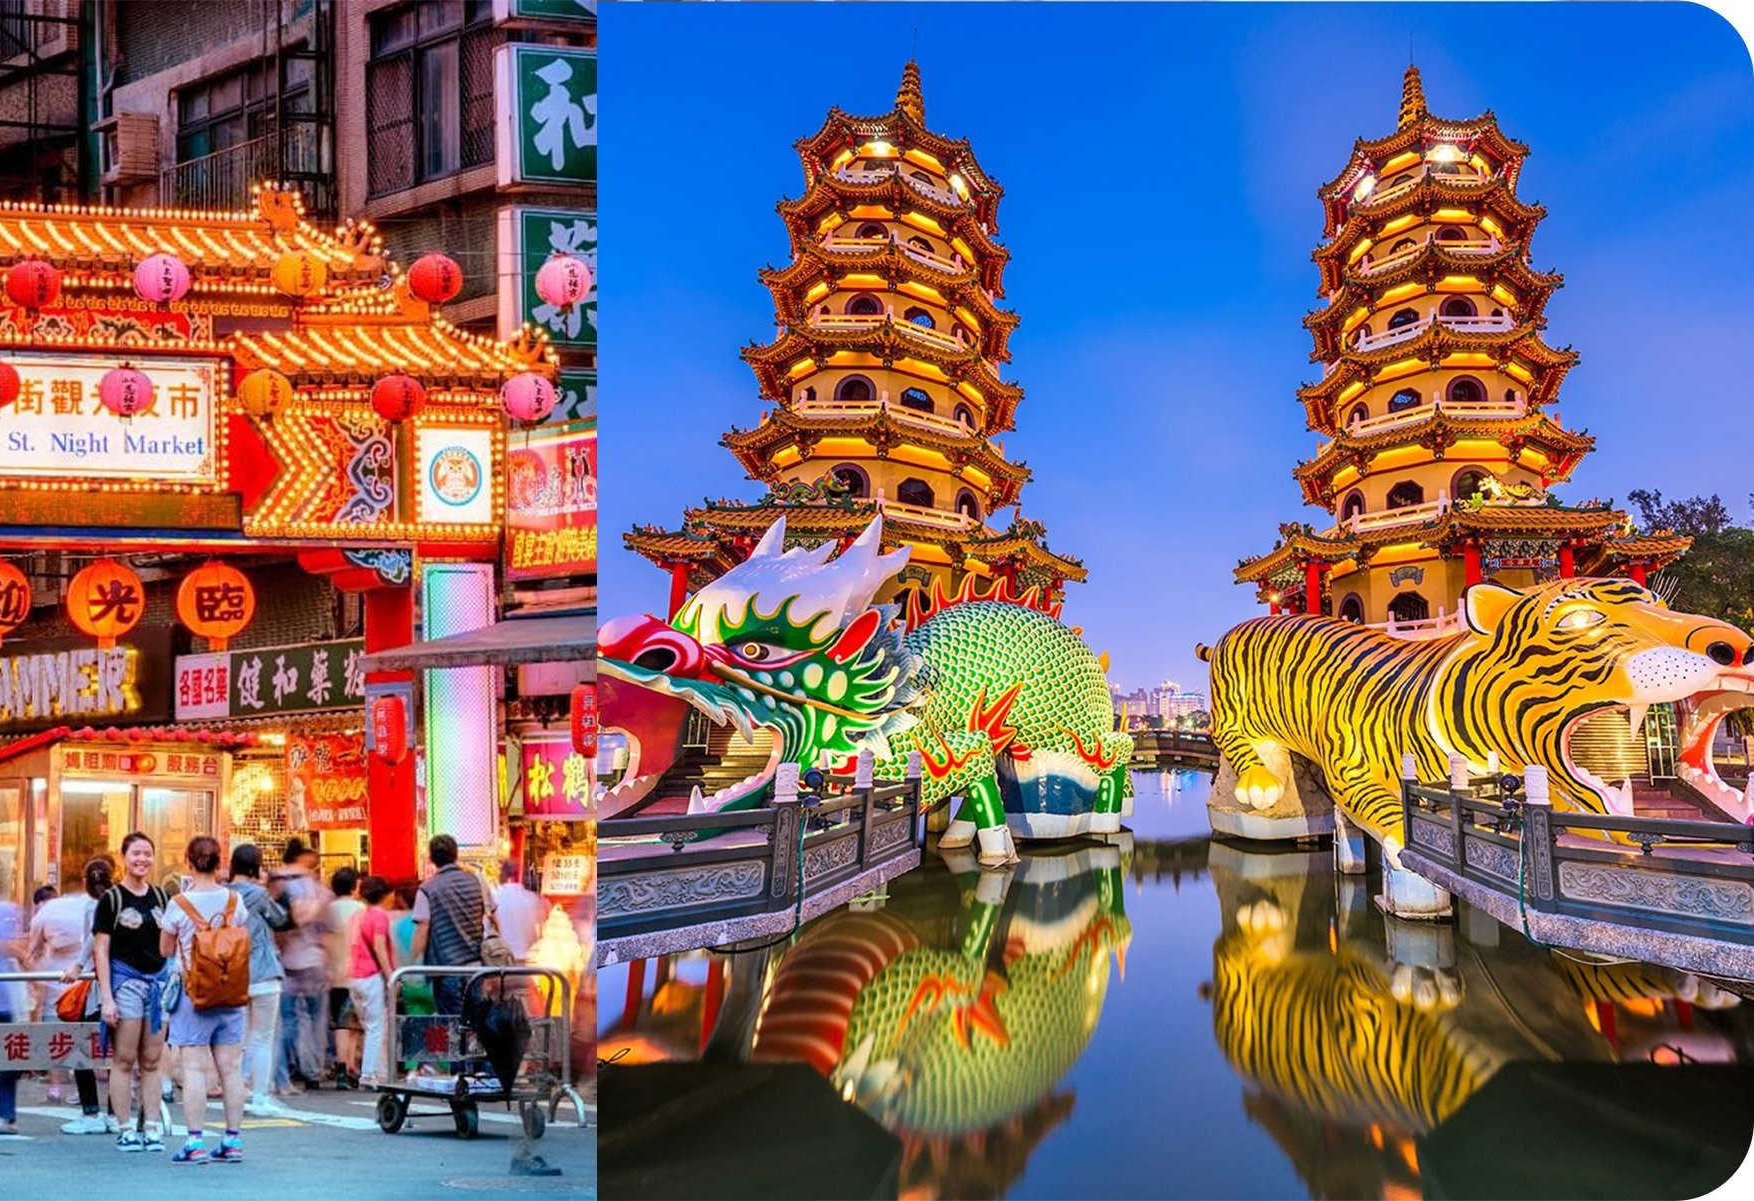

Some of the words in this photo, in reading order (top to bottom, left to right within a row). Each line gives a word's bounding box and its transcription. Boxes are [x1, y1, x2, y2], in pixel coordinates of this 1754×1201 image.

[9, 430, 36, 452] St.
[51, 431, 109, 458] Night
[125, 433, 205, 456] Market
[179, 665, 228, 707] 各國名藥
[166, 754, 219, 775] 服務台
[527, 751, 590, 808] 松鶴
